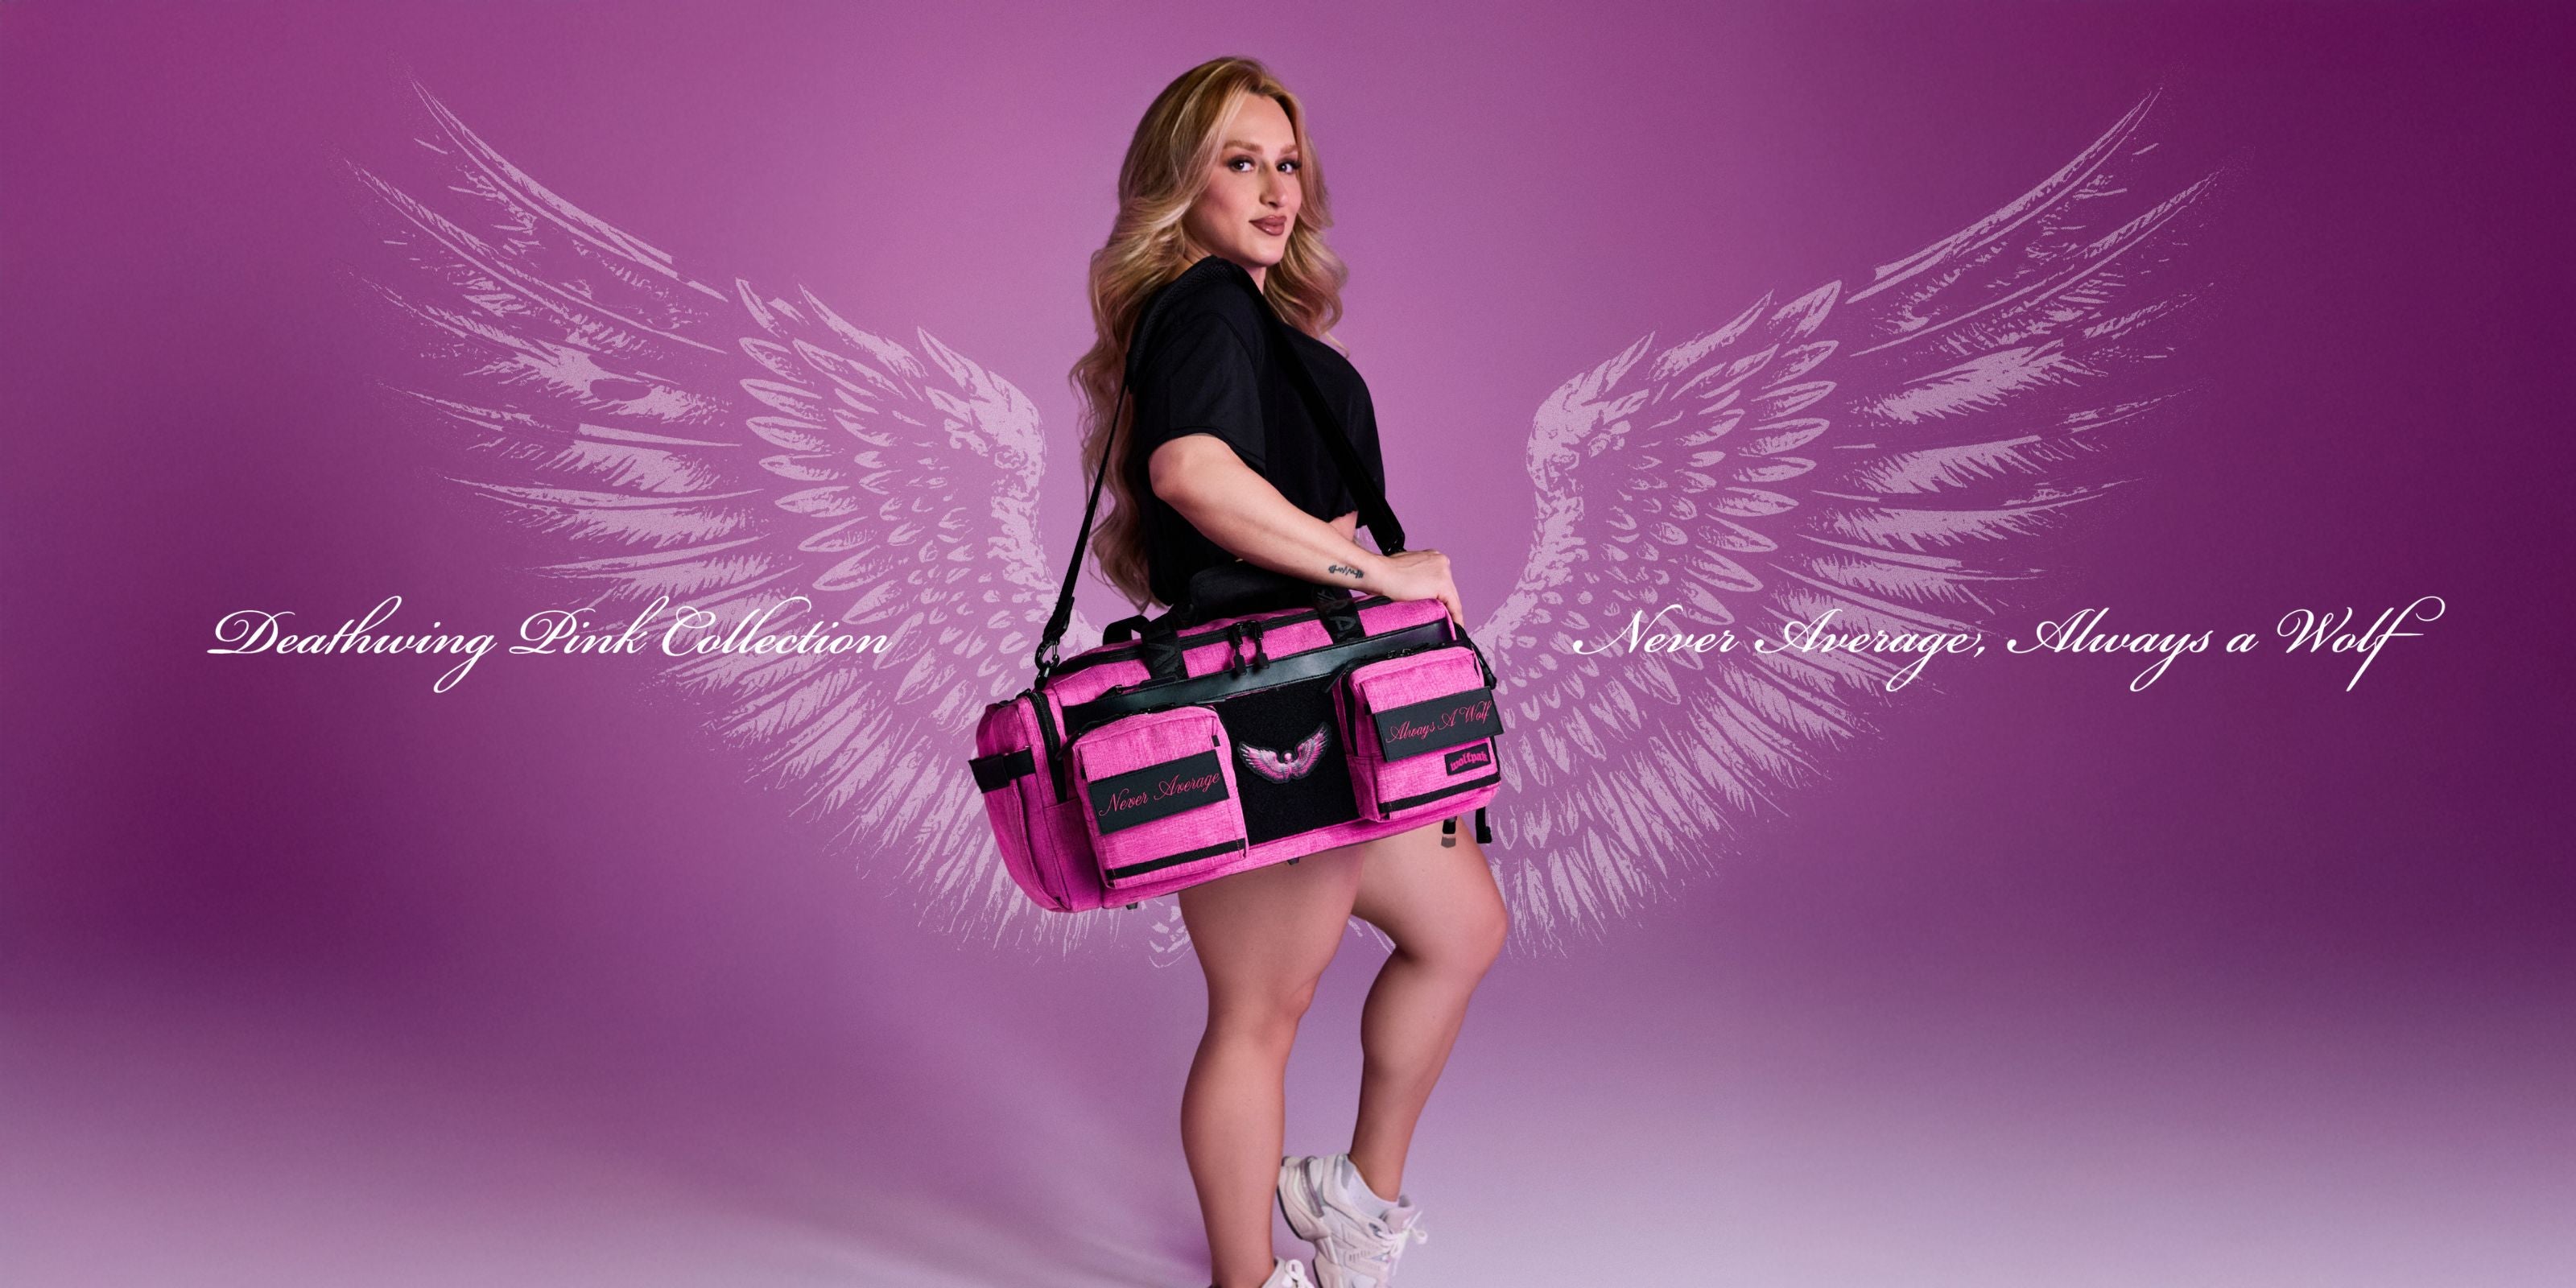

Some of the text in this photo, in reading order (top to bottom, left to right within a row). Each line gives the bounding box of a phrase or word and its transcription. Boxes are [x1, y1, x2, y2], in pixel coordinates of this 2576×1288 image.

[1385, 700, 1492, 744] Always A Wolf
[1098, 772, 1220, 817] Never Average
